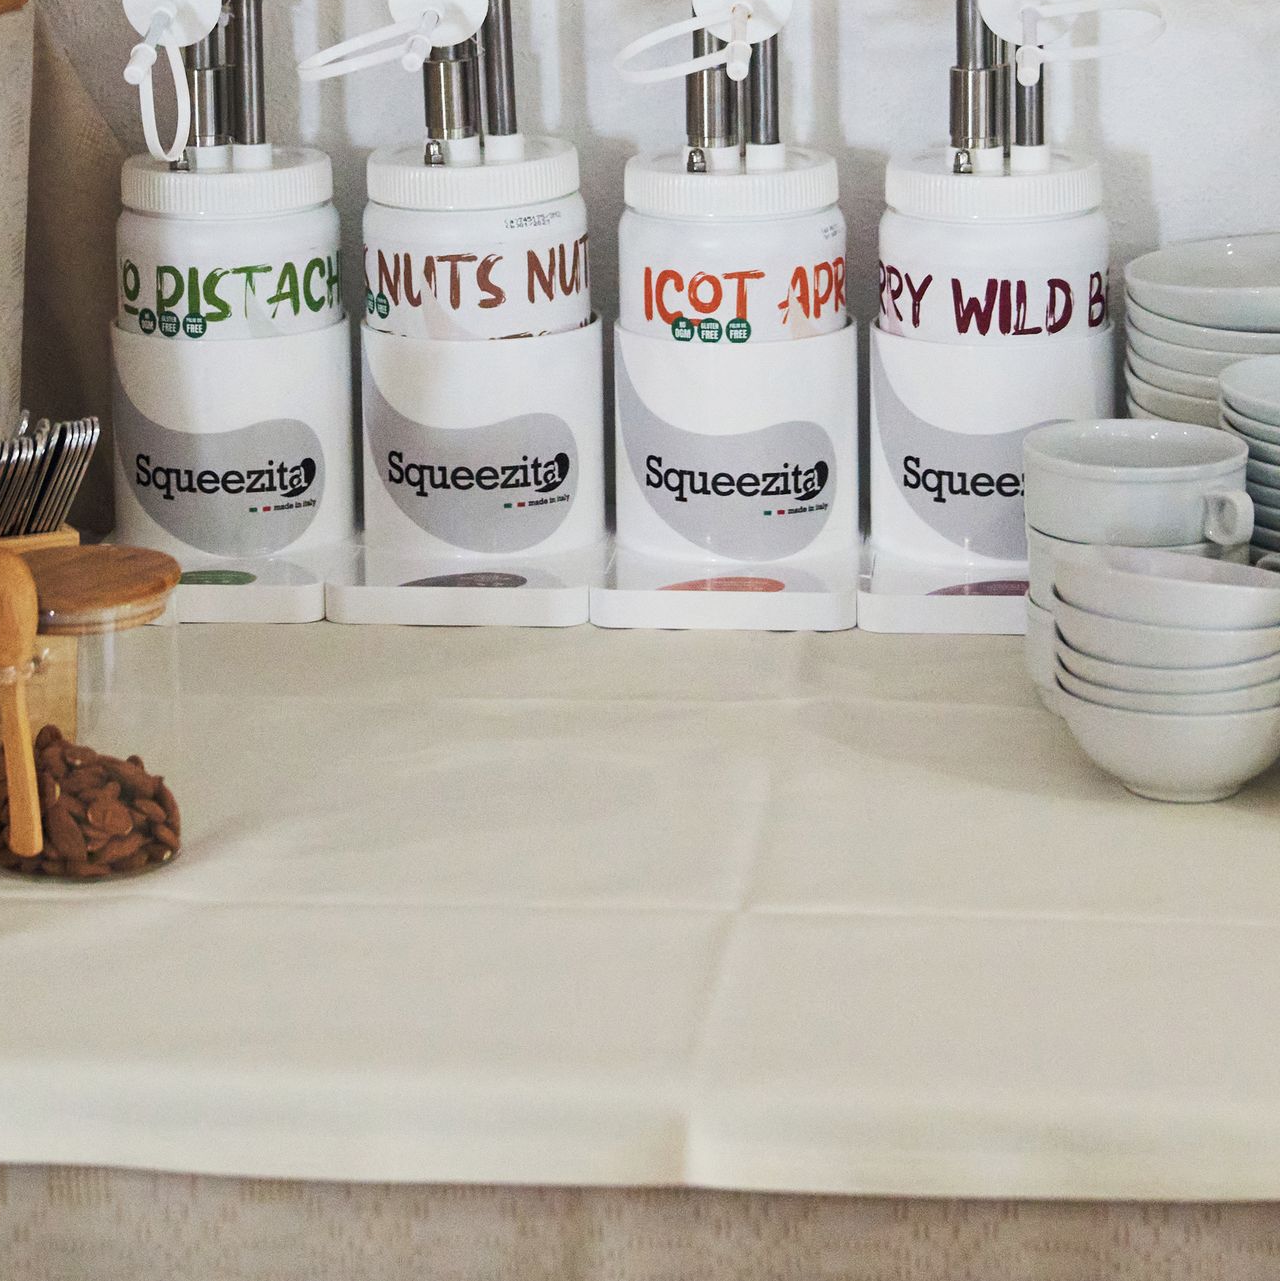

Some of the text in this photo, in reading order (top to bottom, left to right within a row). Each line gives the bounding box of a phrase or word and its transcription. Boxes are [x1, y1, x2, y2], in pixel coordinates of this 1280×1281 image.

[378, 248, 505, 310] NUTS
[644, 266, 766, 327] ICOT
[951, 278, 1074, 336] WILD
[1088, 270, 1110, 328] B
[186, 323, 203, 333] FREE
[701, 330, 719, 339] FREE
[730, 329, 747, 339] FREE
[136, 453, 316, 500] Squeezita
[388, 450, 570, 497] Squeezita
[646, 455, 829, 502] Squeezita
[903, 455, 1025, 503] Squee
[273, 502, 294, 511] made
[303, 499, 316, 509] italy
[528, 494, 570, 507] made in italy
[787, 502, 829, 515] made in italy
